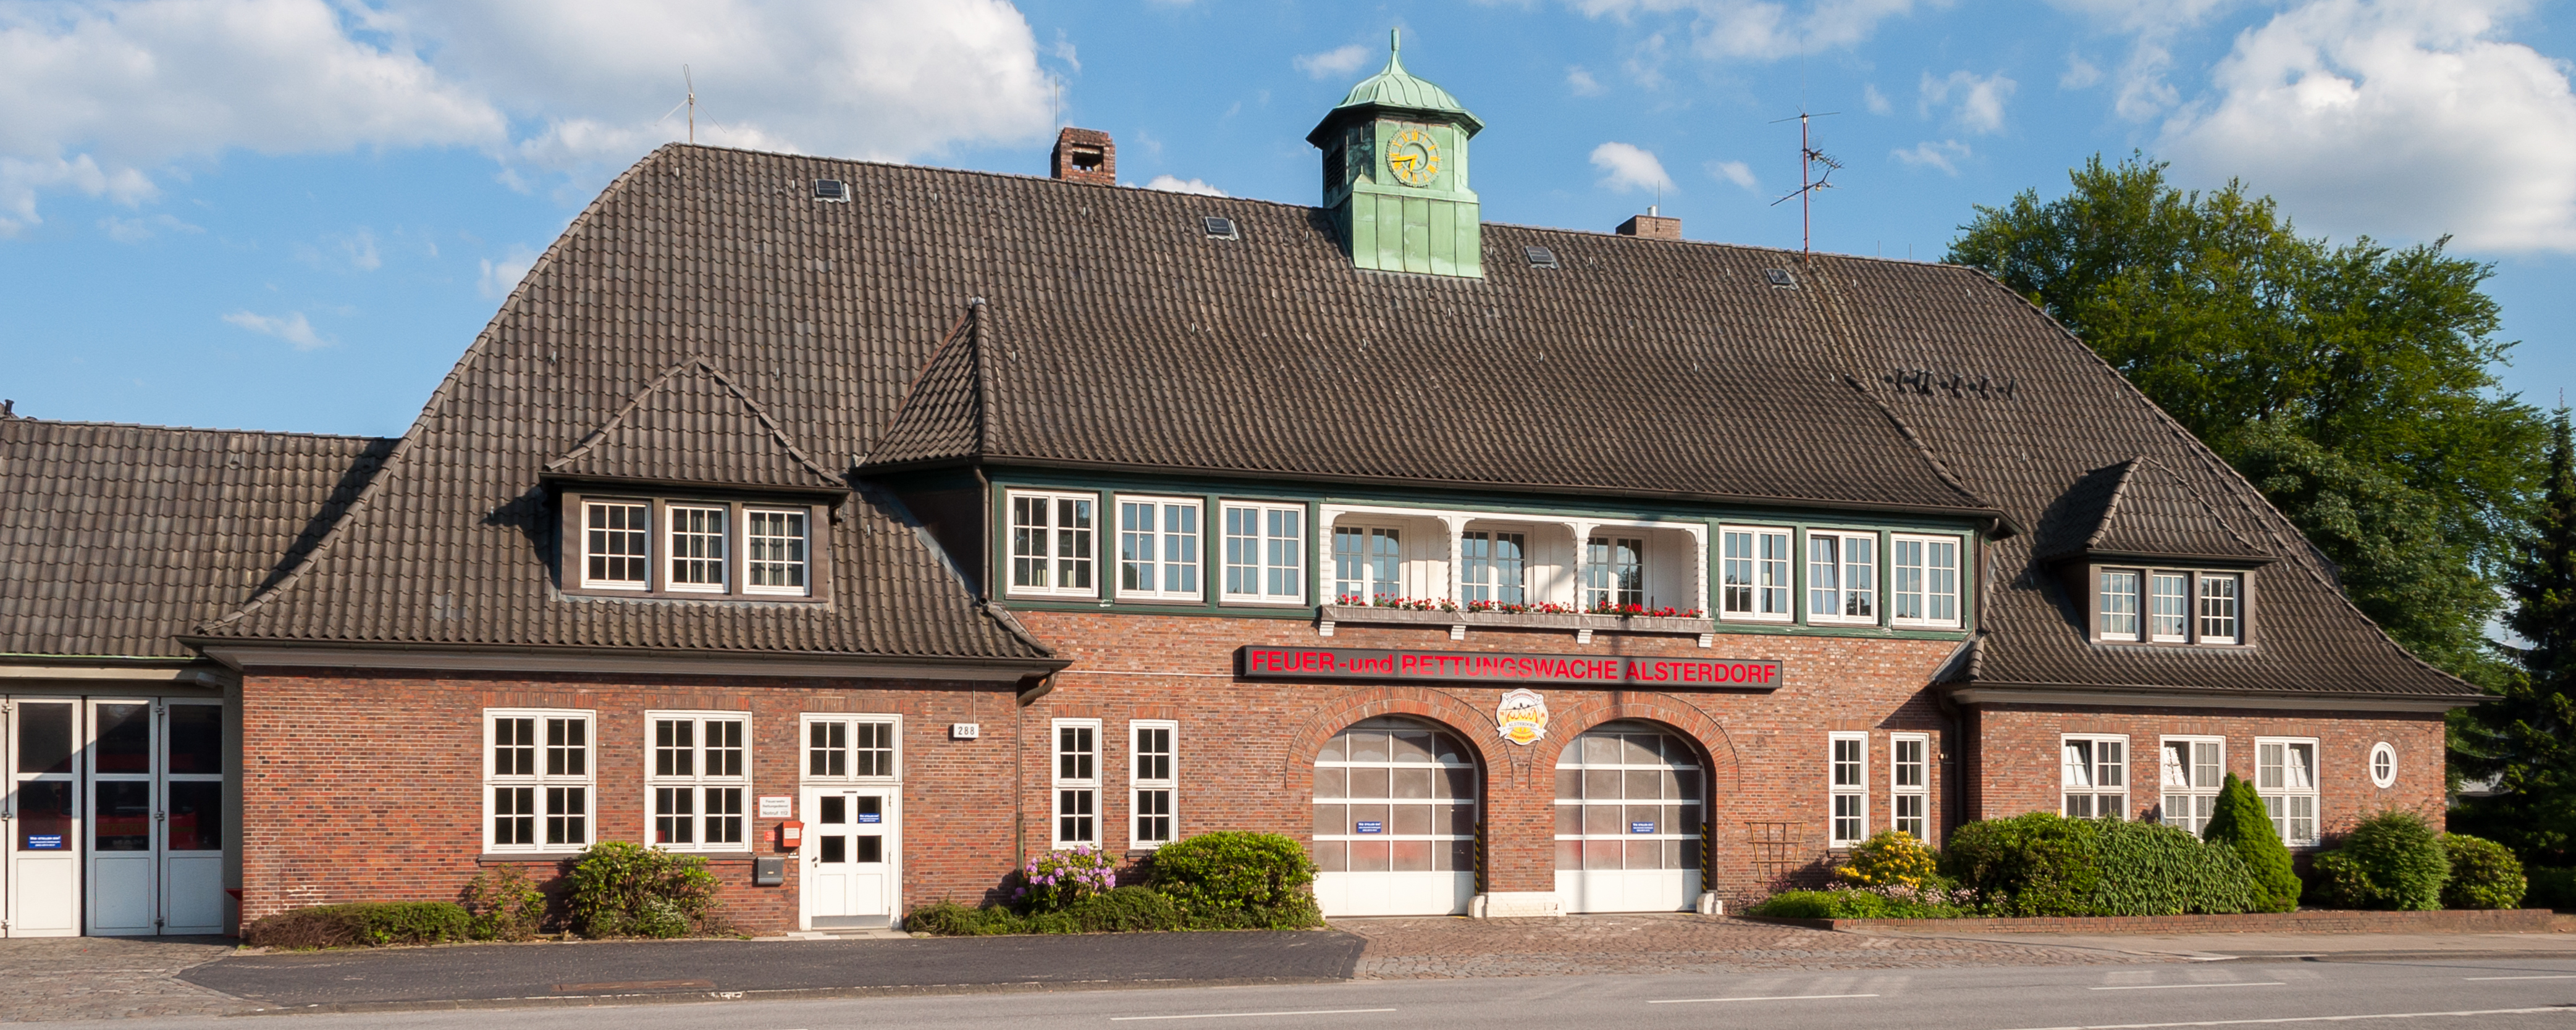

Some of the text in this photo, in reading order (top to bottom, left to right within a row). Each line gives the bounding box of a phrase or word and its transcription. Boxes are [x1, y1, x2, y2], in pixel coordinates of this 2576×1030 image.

[1402, 654, 1618, 679] RETTUNGSWACHE
[1625, 661, 1776, 684] ALSTERDORF
[958, 726, 974, 735] 288
